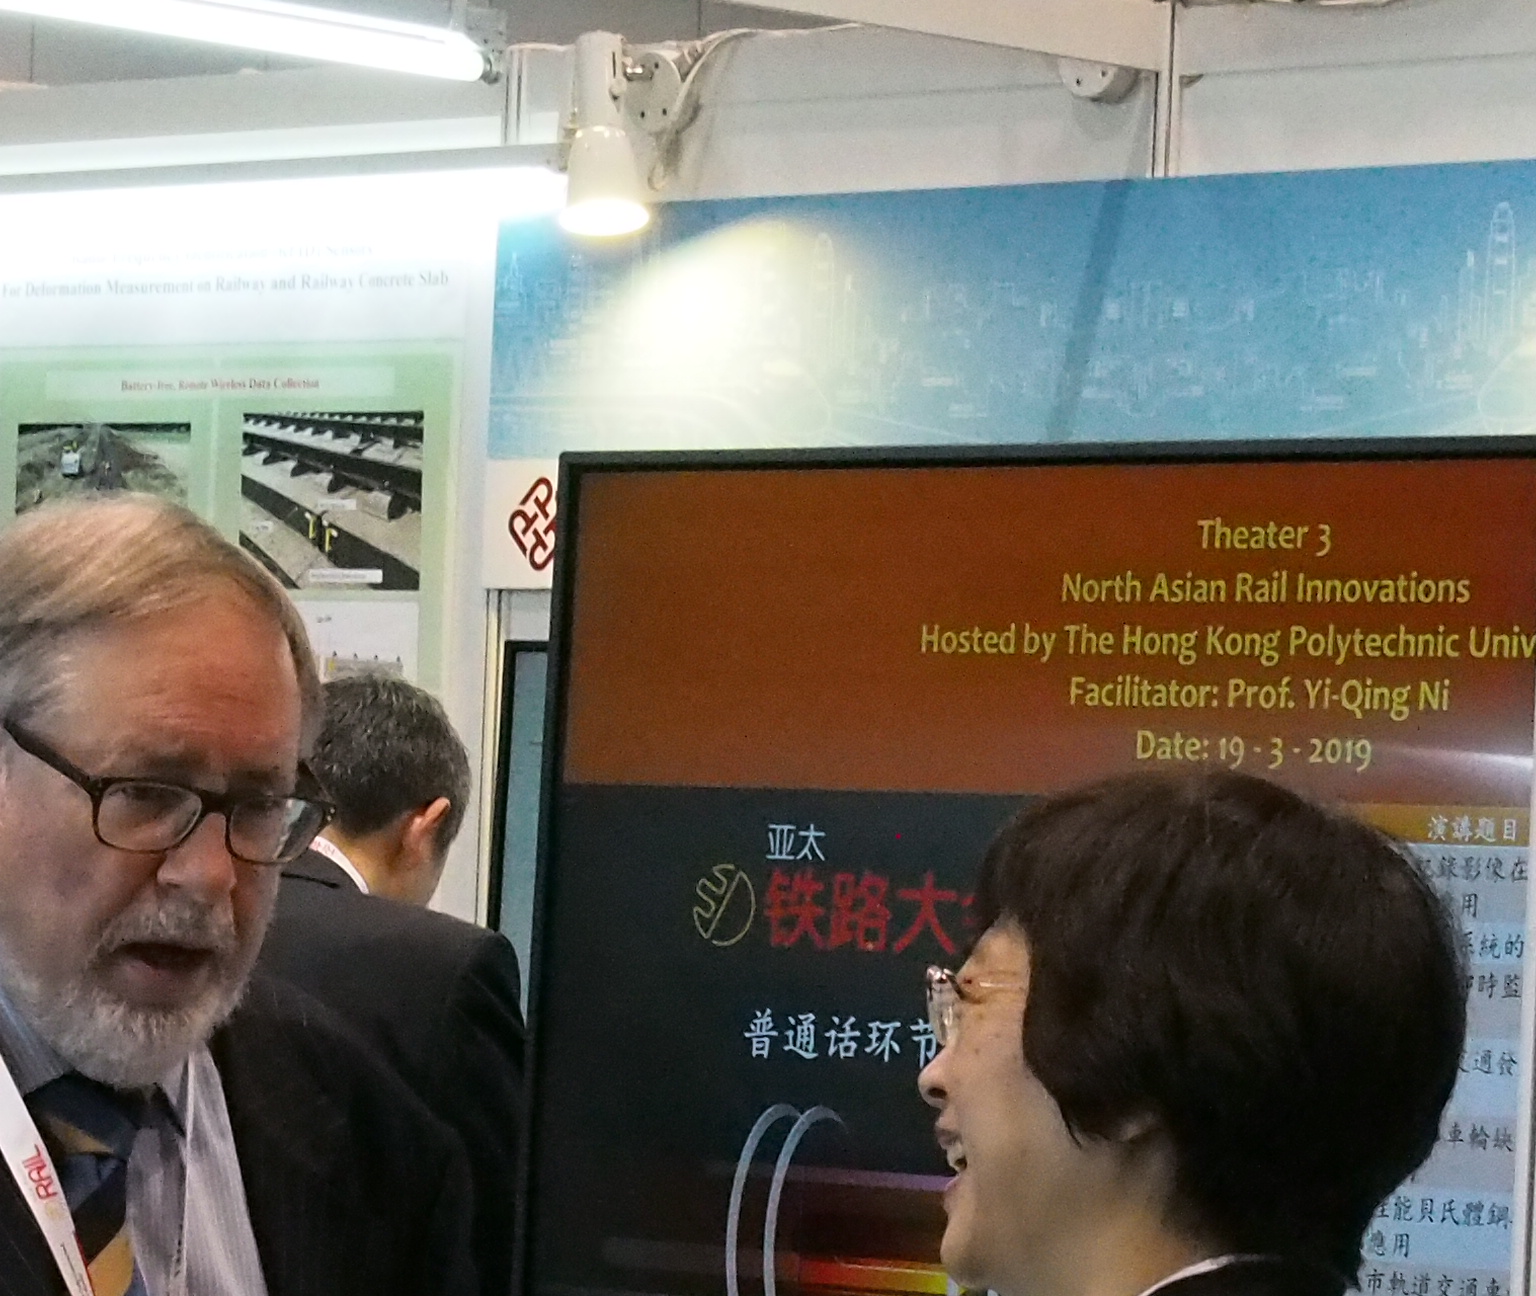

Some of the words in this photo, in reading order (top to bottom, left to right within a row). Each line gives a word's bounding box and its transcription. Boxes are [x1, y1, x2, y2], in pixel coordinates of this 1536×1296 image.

[1197, 519, 1308, 549] Theater
[1316, 524, 1332, 558] 3
[1061, 572, 1141, 602] North
[1148, 573, 1226, 603] Asian
[1235, 571, 1287, 603] Rail
[1296, 572, 1471, 604] Innovations
[920, 623, 1015, 656] Hosted
[1022, 623, 1056, 663] by
[1065, 624, 1114, 656] The
[1122, 626, 1197, 666] Hong
[1206, 626, 1280, 666] Kong
[1289, 624, 1460, 667] Polytechnic
[1469, 626, 1536, 660] Univ
[1068, 676, 1219, 709] Facilitator:
[1227, 678, 1296, 710] Prof.
[1304, 679, 1411, 721] Yi-Qing
[1418, 680, 1449, 712] Ni
[1136, 730, 1209, 761] Date:
[1218, 738, 1245, 770] 19
[1269, 737, 1283, 770] 3
[1308, 738, 1372, 772] 2019
[765, 823, 827, 862] 亚太
[764, 868, 977, 955] 铁路大
[743, 1007, 938, 1069] 普通话环节
[22, 1143, 59, 1201] RAIL
